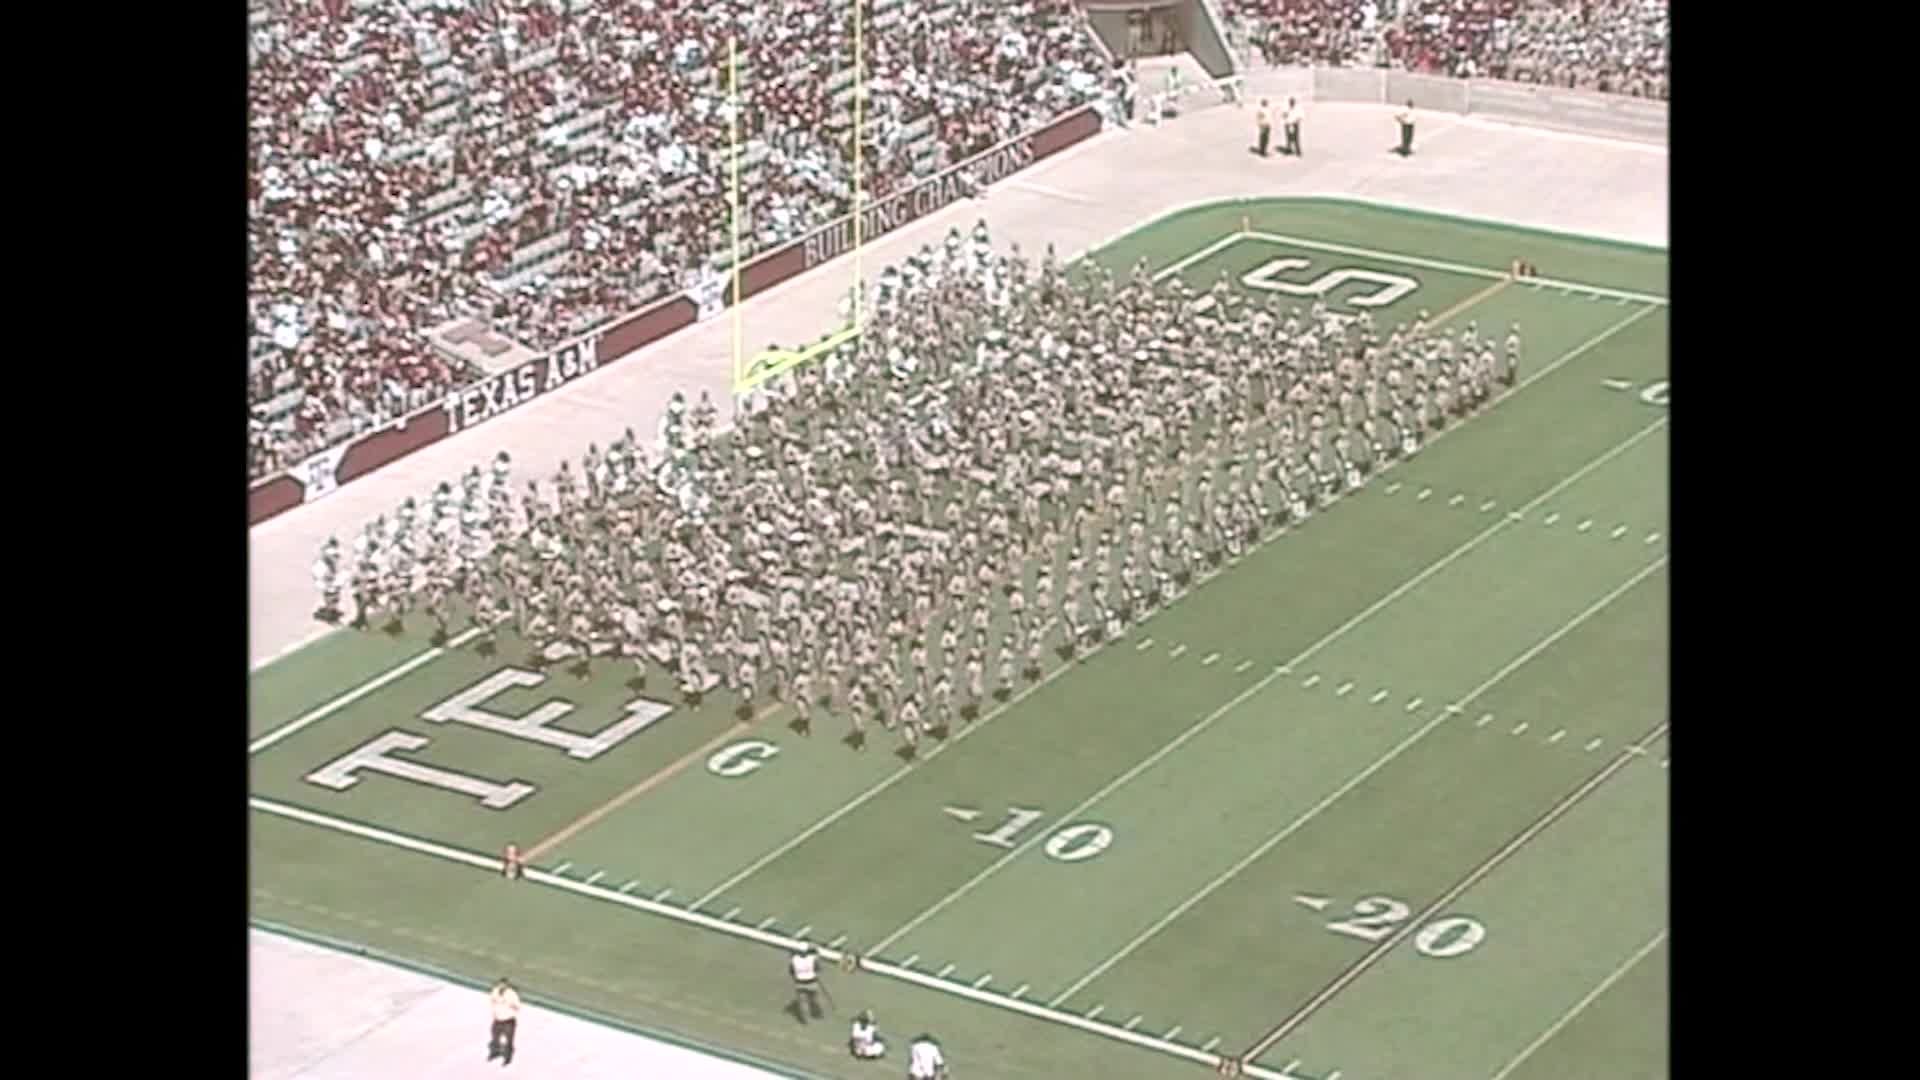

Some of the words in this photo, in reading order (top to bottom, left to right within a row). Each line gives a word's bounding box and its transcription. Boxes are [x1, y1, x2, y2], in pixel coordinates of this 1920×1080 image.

[804, 196, 907, 269] BUILDING
[914, 136, 1034, 216] CHAPIONS
[442, 364, 537, 433] TEXAS
[545, 336, 602, 391] A&M
[707, 740, 781, 776] G
